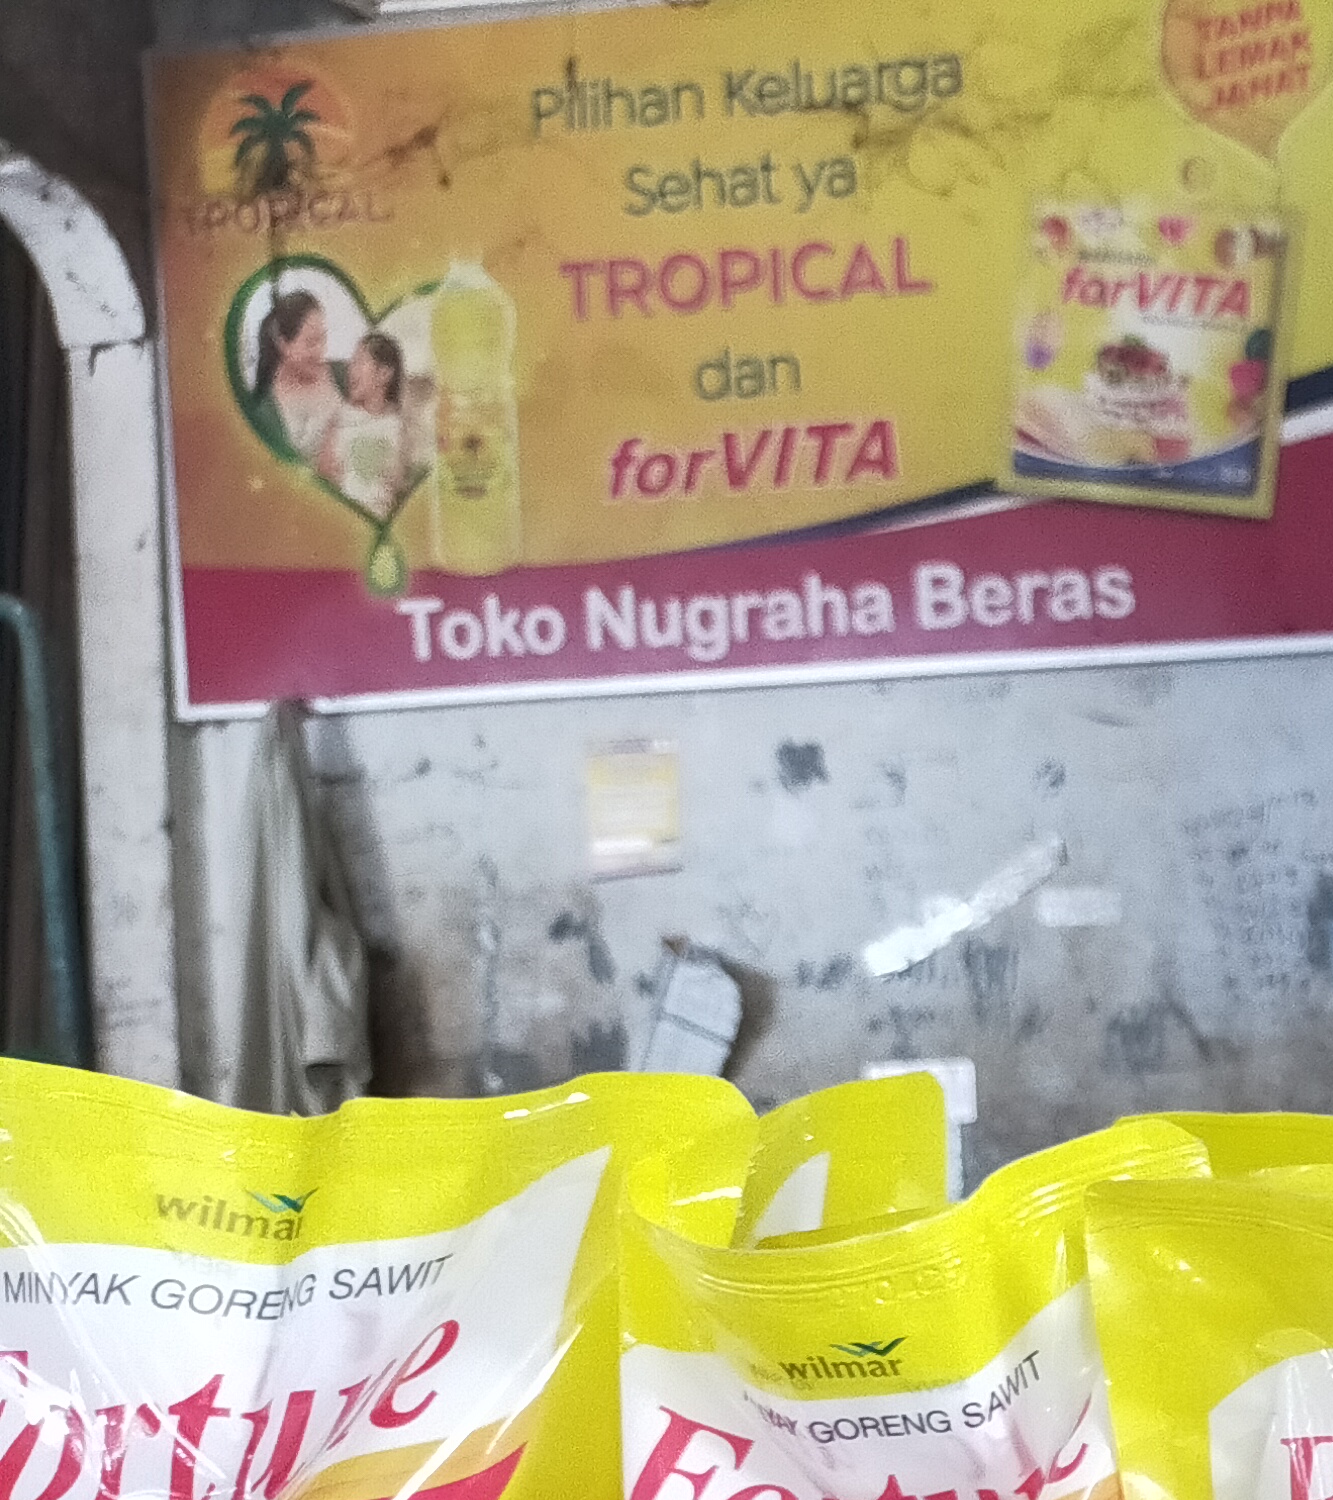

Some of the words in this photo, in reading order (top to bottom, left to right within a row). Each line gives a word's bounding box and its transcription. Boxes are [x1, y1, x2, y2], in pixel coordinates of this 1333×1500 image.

[531, 78, 704, 137] Pilihan
[724, 53, 964, 118] Keluarga
[624, 154, 781, 217] Sehat
[793, 152, 858, 203] ya
[560, 237, 935, 324] TROPICAL
[1061, 266, 1250, 318] forVITA
[692, 345, 800, 403] dan
[610, 420, 899, 499] forVITA
[398, 592, 567, 662] Toko
[584, 572, 896, 661] Nugraha
[914, 560, 1137, 632] Beras
[2, 1271, 141, 1307] MINYAK
[150, 1273, 317, 1321] GORENG
[328, 1253, 455, 1301] SAWIT
[779, 1354, 903, 1382] wilmar
[808, 1409, 952, 1444] GORENG
[961, 1350, 1041, 1429] SAWIT
